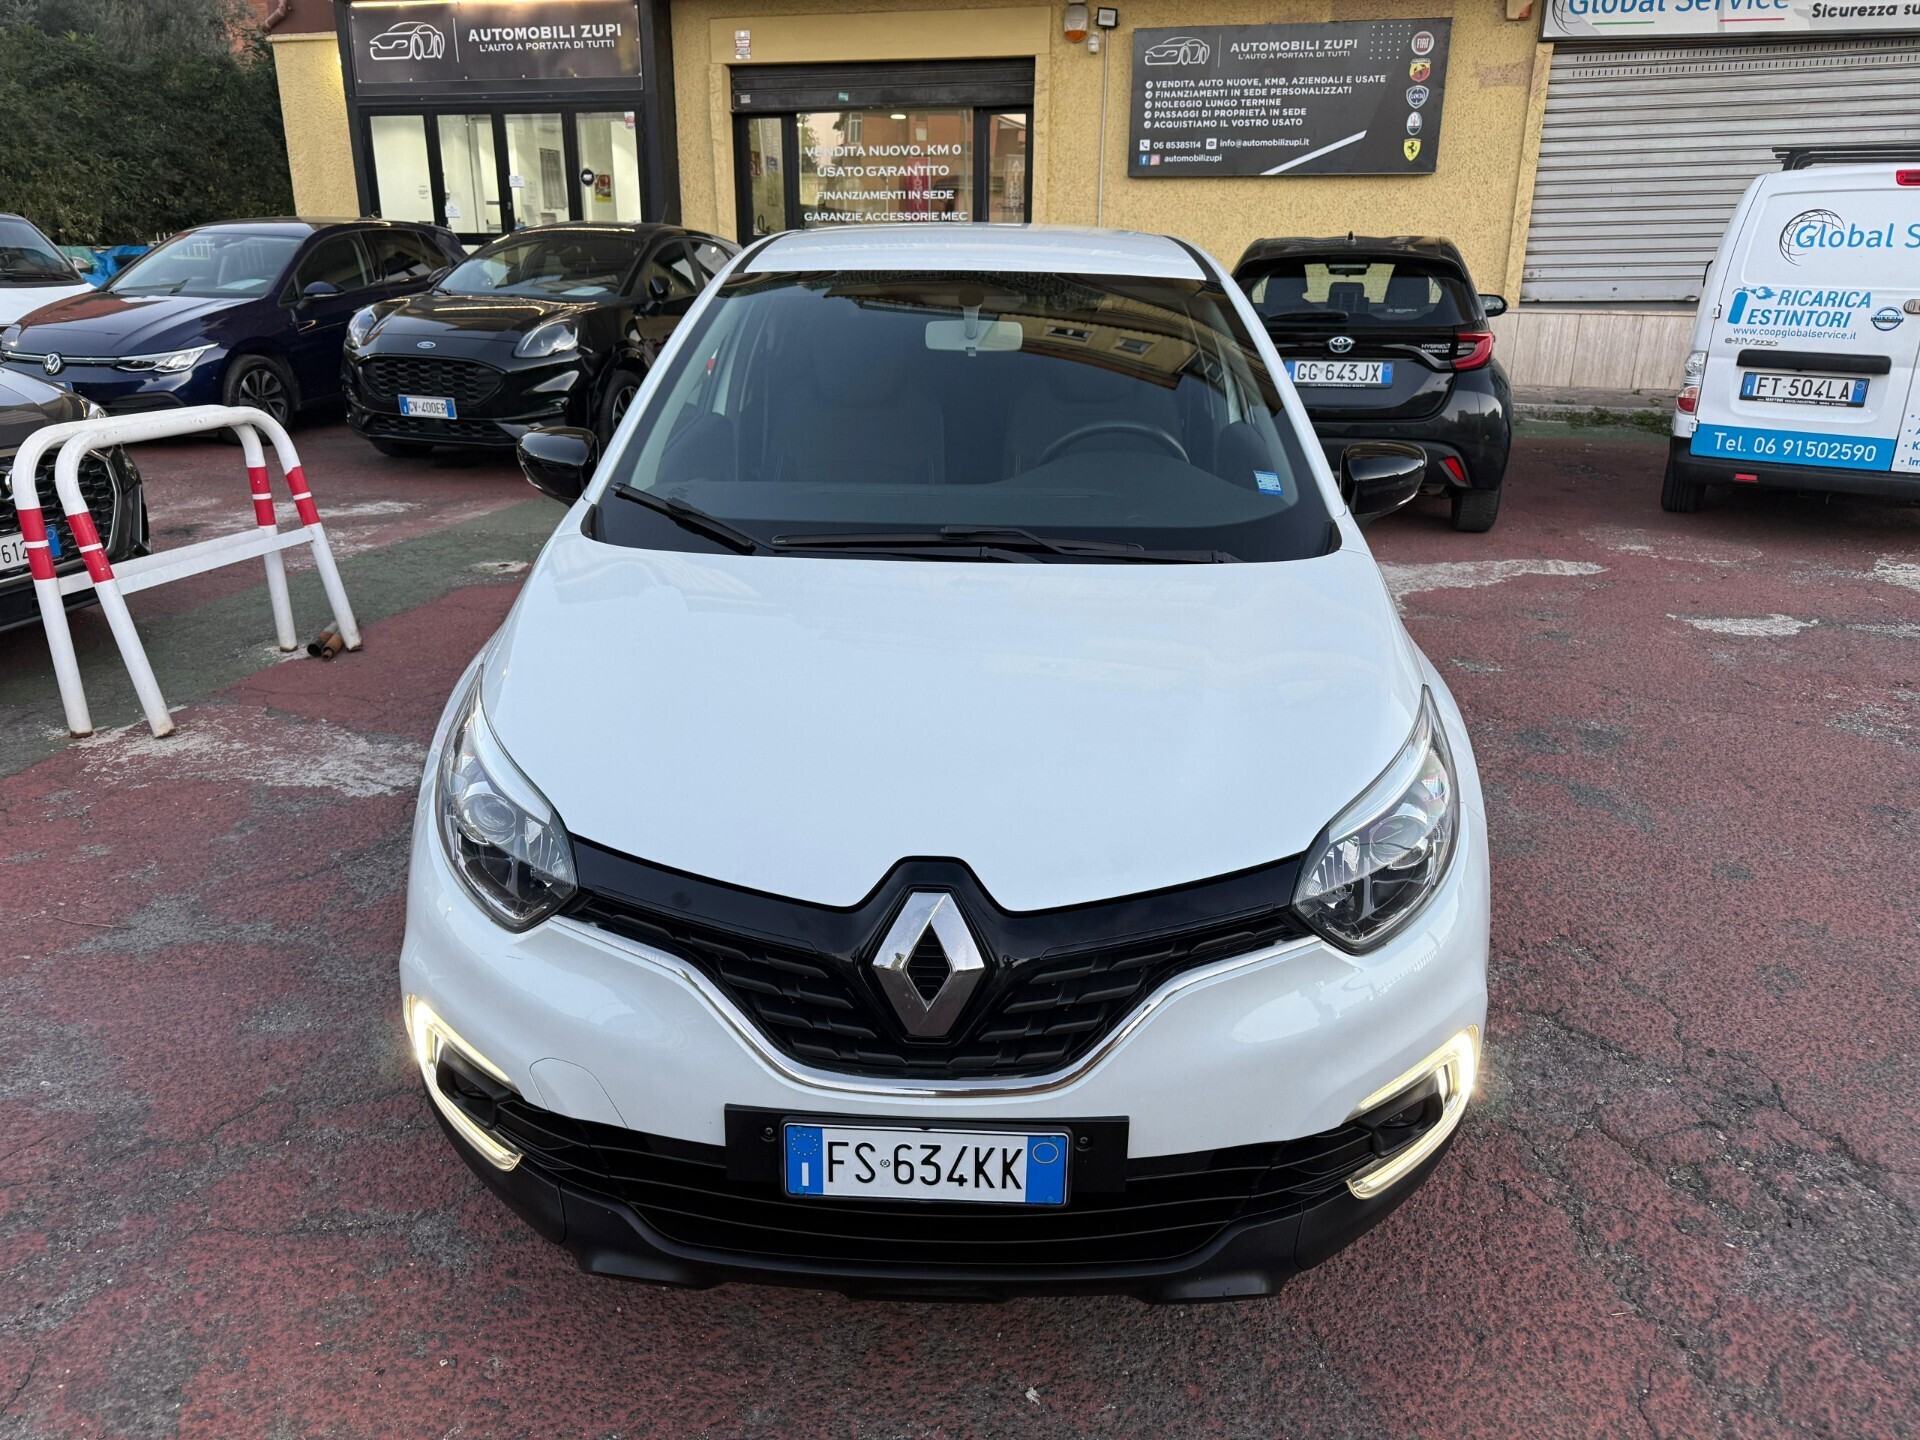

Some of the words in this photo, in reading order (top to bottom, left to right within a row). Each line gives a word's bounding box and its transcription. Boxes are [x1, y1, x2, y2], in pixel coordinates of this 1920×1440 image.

[1811, 3, 1897, 18] Sicurezza
[468, 25, 576, 42] AUTOMOBILI
[580, 23, 622, 38] ZUPI
[479, 43, 514, 52] L'AUTO
[526, 41, 571, 50] PORTATA
[574, 40, 584, 48] DI
[586, 39, 615, 48] TUTTI
[1230, 40, 1319, 53] AUTOMOBILI
[1324, 39, 1358, 49] ZUPI
[1416, 37, 1429, 49] FIAT
[1156, 80, 1195, 88] VENDITA
[1198, 79, 1223, 87] AUTO
[1226, 78, 1262, 87] NUOVE,
[1291, 76, 1343, 85] AZIENDALI
[1355, 75, 1386, 83] USATE
[1155, 89, 1228, 98] FINANZIAMENTI
[1243, 88, 1267, 96] SEDE
[1270, 86, 1352, 96] PERSONALIZZATI
[1154, 100, 1202, 108] NOLEGGIO
[1205, 99, 1237, 107] LUNGO
[1240, 98, 1281, 107] TERMINE
[1154, 110, 1199, 118] PASSAGGI
[1214, 107, 1266, 117] PROPRIETÀ
[1269, 108, 1280, 116] IN
[1282, 108, 1307, 116] SEDE
[1154, 120, 1217, 129] ACQUISTIAMO
[1231, 119, 1269, 127] VOSTRO
[1271, 118, 1303, 126] USATO
[1153, 141, 1164, 149] 06
[1165, 141, 1201, 149] 85385114
[1220, 138, 1310, 149] info@automobilizupi.it
[805, 146, 866, 157] VENDITA
[869, 145, 924, 157] NUOVO,
[927, 145, 949, 155] KM
[952, 144, 962, 155] 0
[1164, 154, 1222, 163] automobilizupi
[817, 166, 864, 177] USATO
[866, 165, 950, 177] GARANTITO
[817, 190, 906, 200] FINANZIAMENTI
[908, 191, 921, 200] IN
[922, 190, 955, 200] SEDE
[804, 212, 862, 221] GARANZIE
[865, 212, 939, 221] ACCESSORIE
[941, 211, 968, 221] MEC
[1796, 223, 1894, 248] Global
[1777, 289, 1872, 309] RICARICA
[1747, 309, 1852, 329] ESTINTORI
[1733, 327, 1857, 340] www.coopglobalservice.it
[1714, 432, 1746, 452] Tel.
[1753, 436, 1776, 454] 06
[1783, 439, 1877, 462] 91502590
